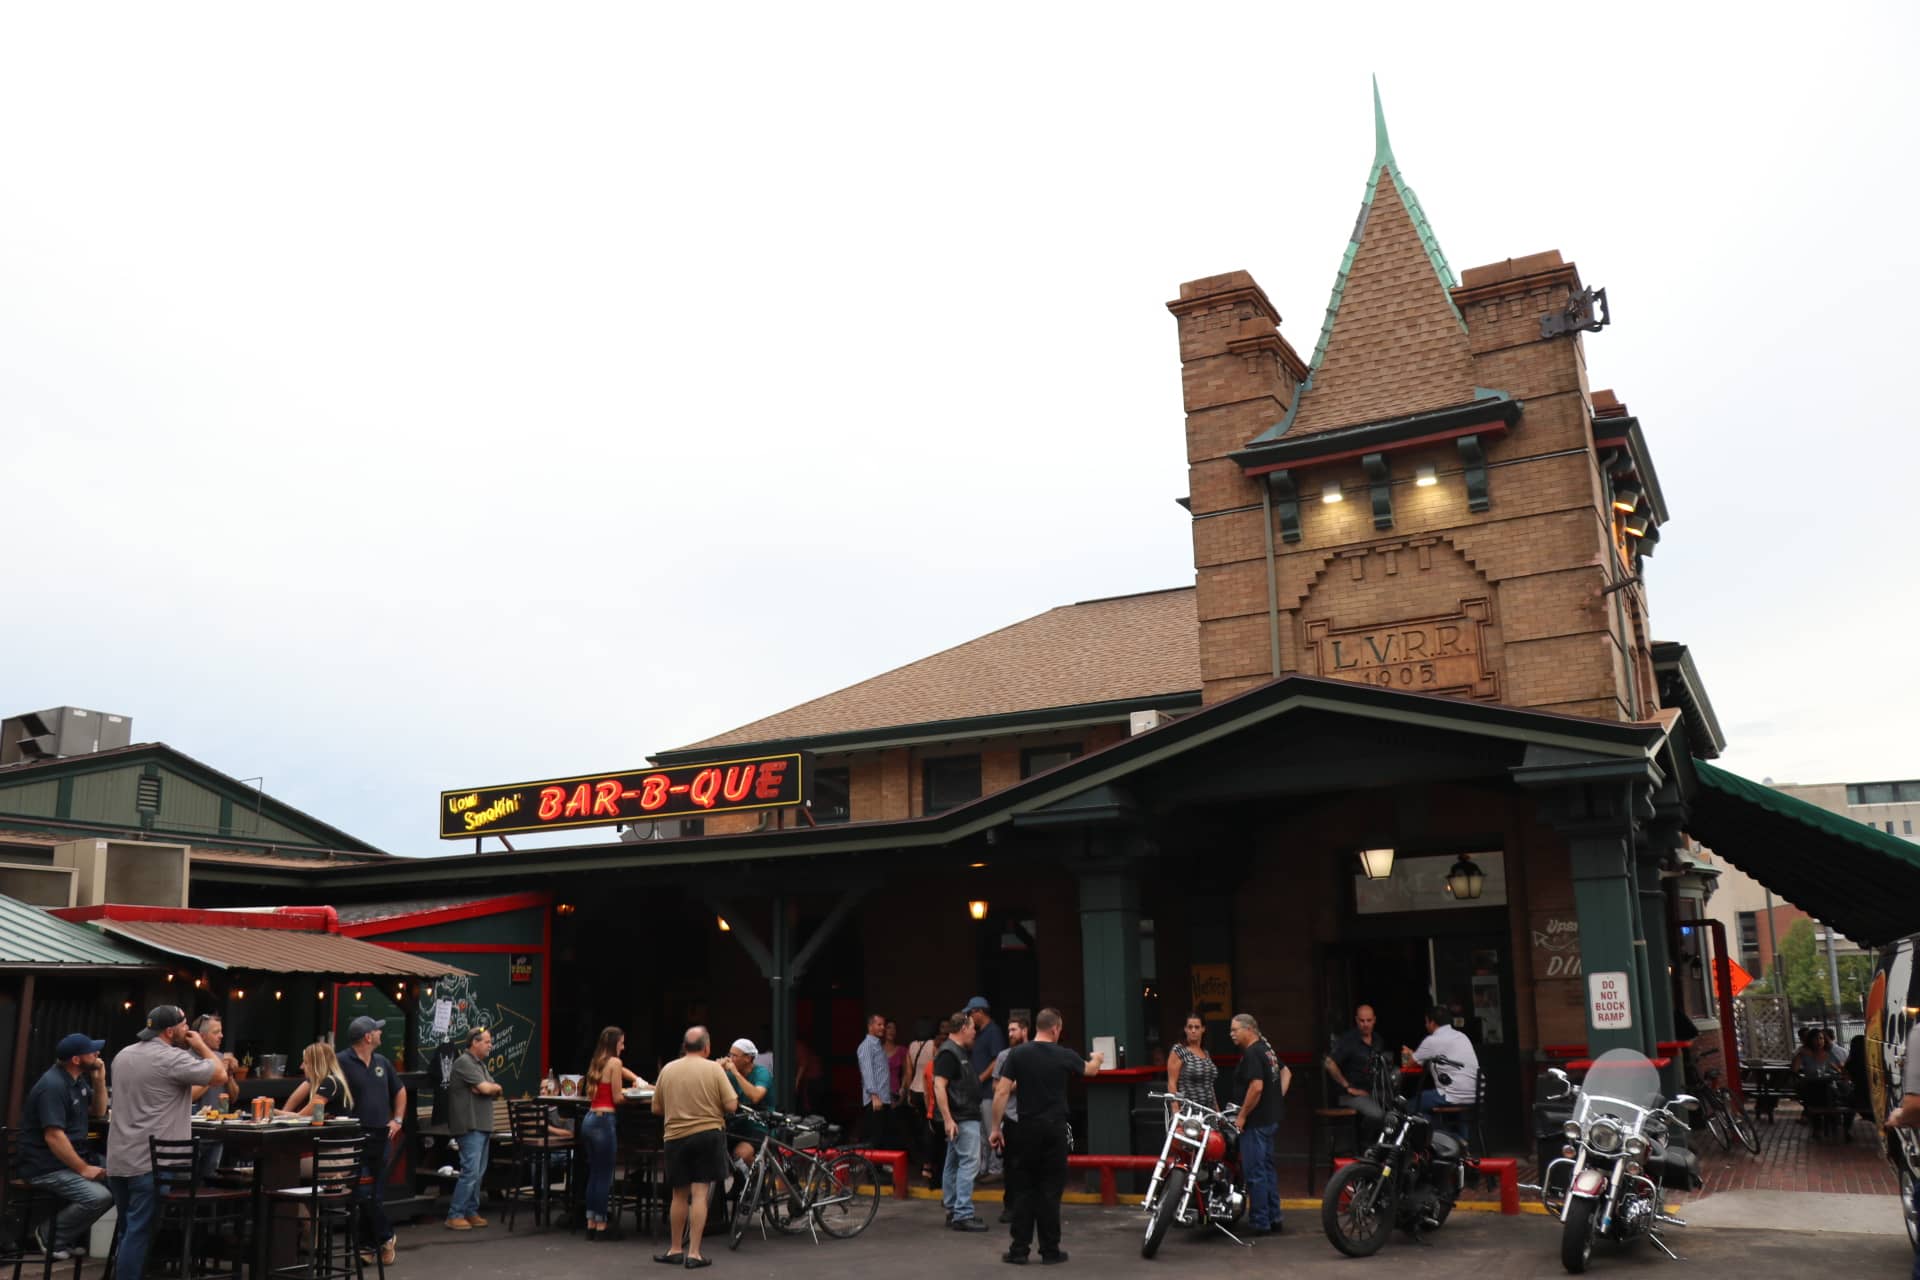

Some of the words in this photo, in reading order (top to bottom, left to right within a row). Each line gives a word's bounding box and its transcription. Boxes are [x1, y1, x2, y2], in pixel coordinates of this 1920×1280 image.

[1363, 664, 1435, 687] 1905
[537, 761, 787, 822] BAR-B-QUE
[1602, 980, 1615, 989] DO
[1600, 991, 1618, 1000] NOT
[1595, 1001, 1625, 1011] BLOCK
[1598, 1012, 1624, 1022] RAMP
